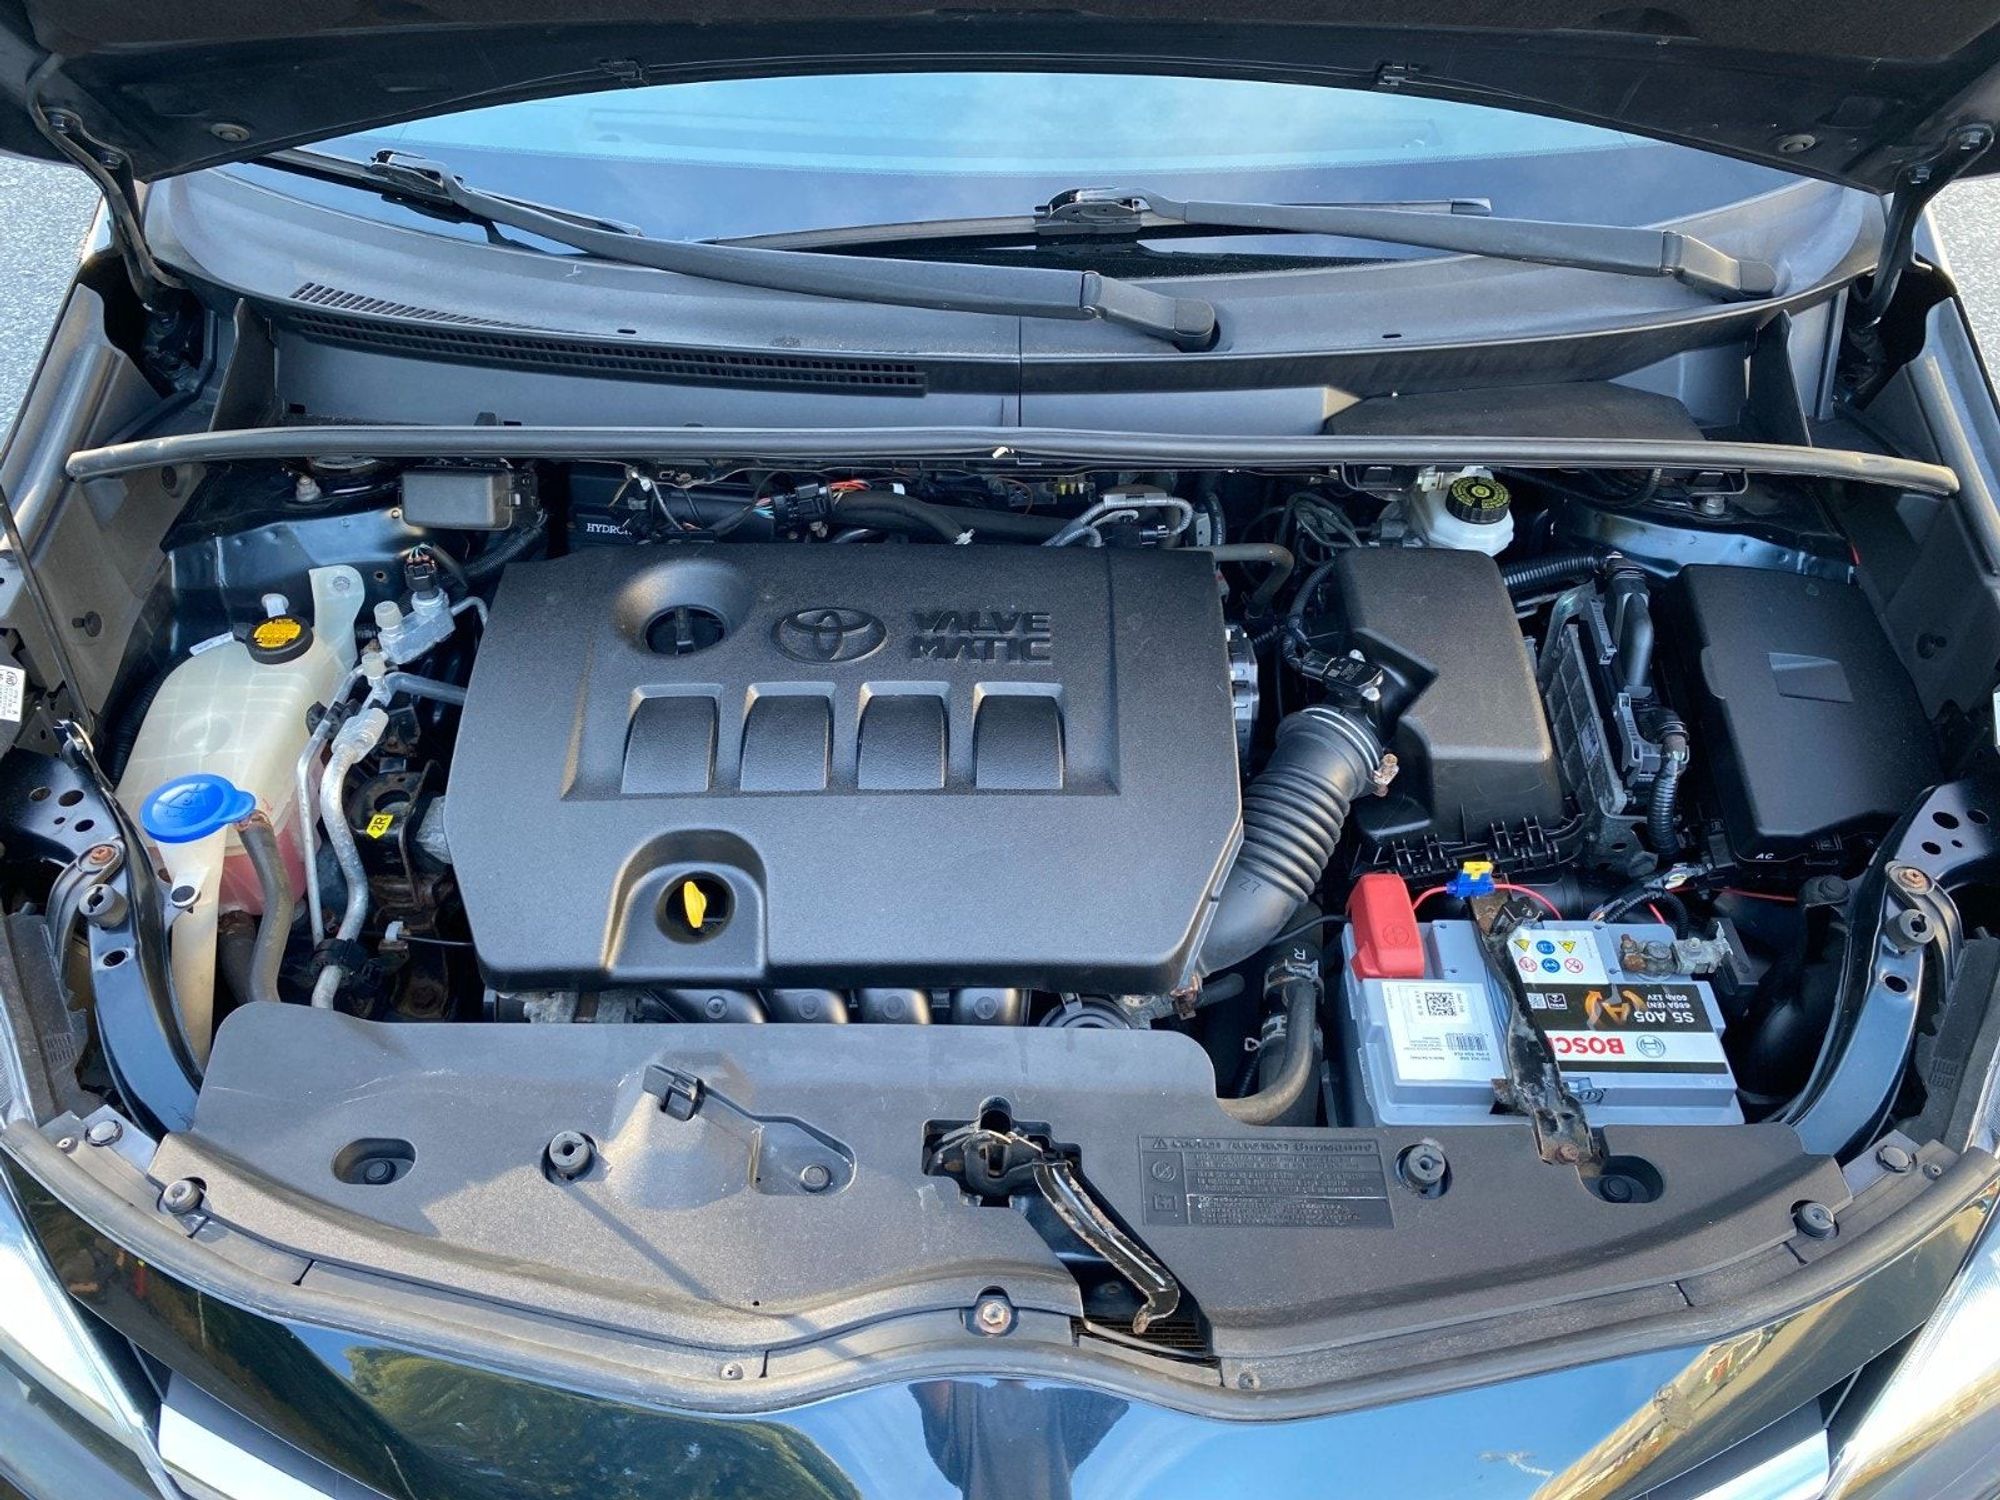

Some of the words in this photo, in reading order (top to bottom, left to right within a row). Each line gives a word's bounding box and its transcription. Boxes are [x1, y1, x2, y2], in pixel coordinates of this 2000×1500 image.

[912, 611, 1051, 633] VALVE
[911, 636, 1052, 662] MATIC
[1633, 1010, 1667, 1024] A05
[1671, 1011, 1696, 1024] S5
